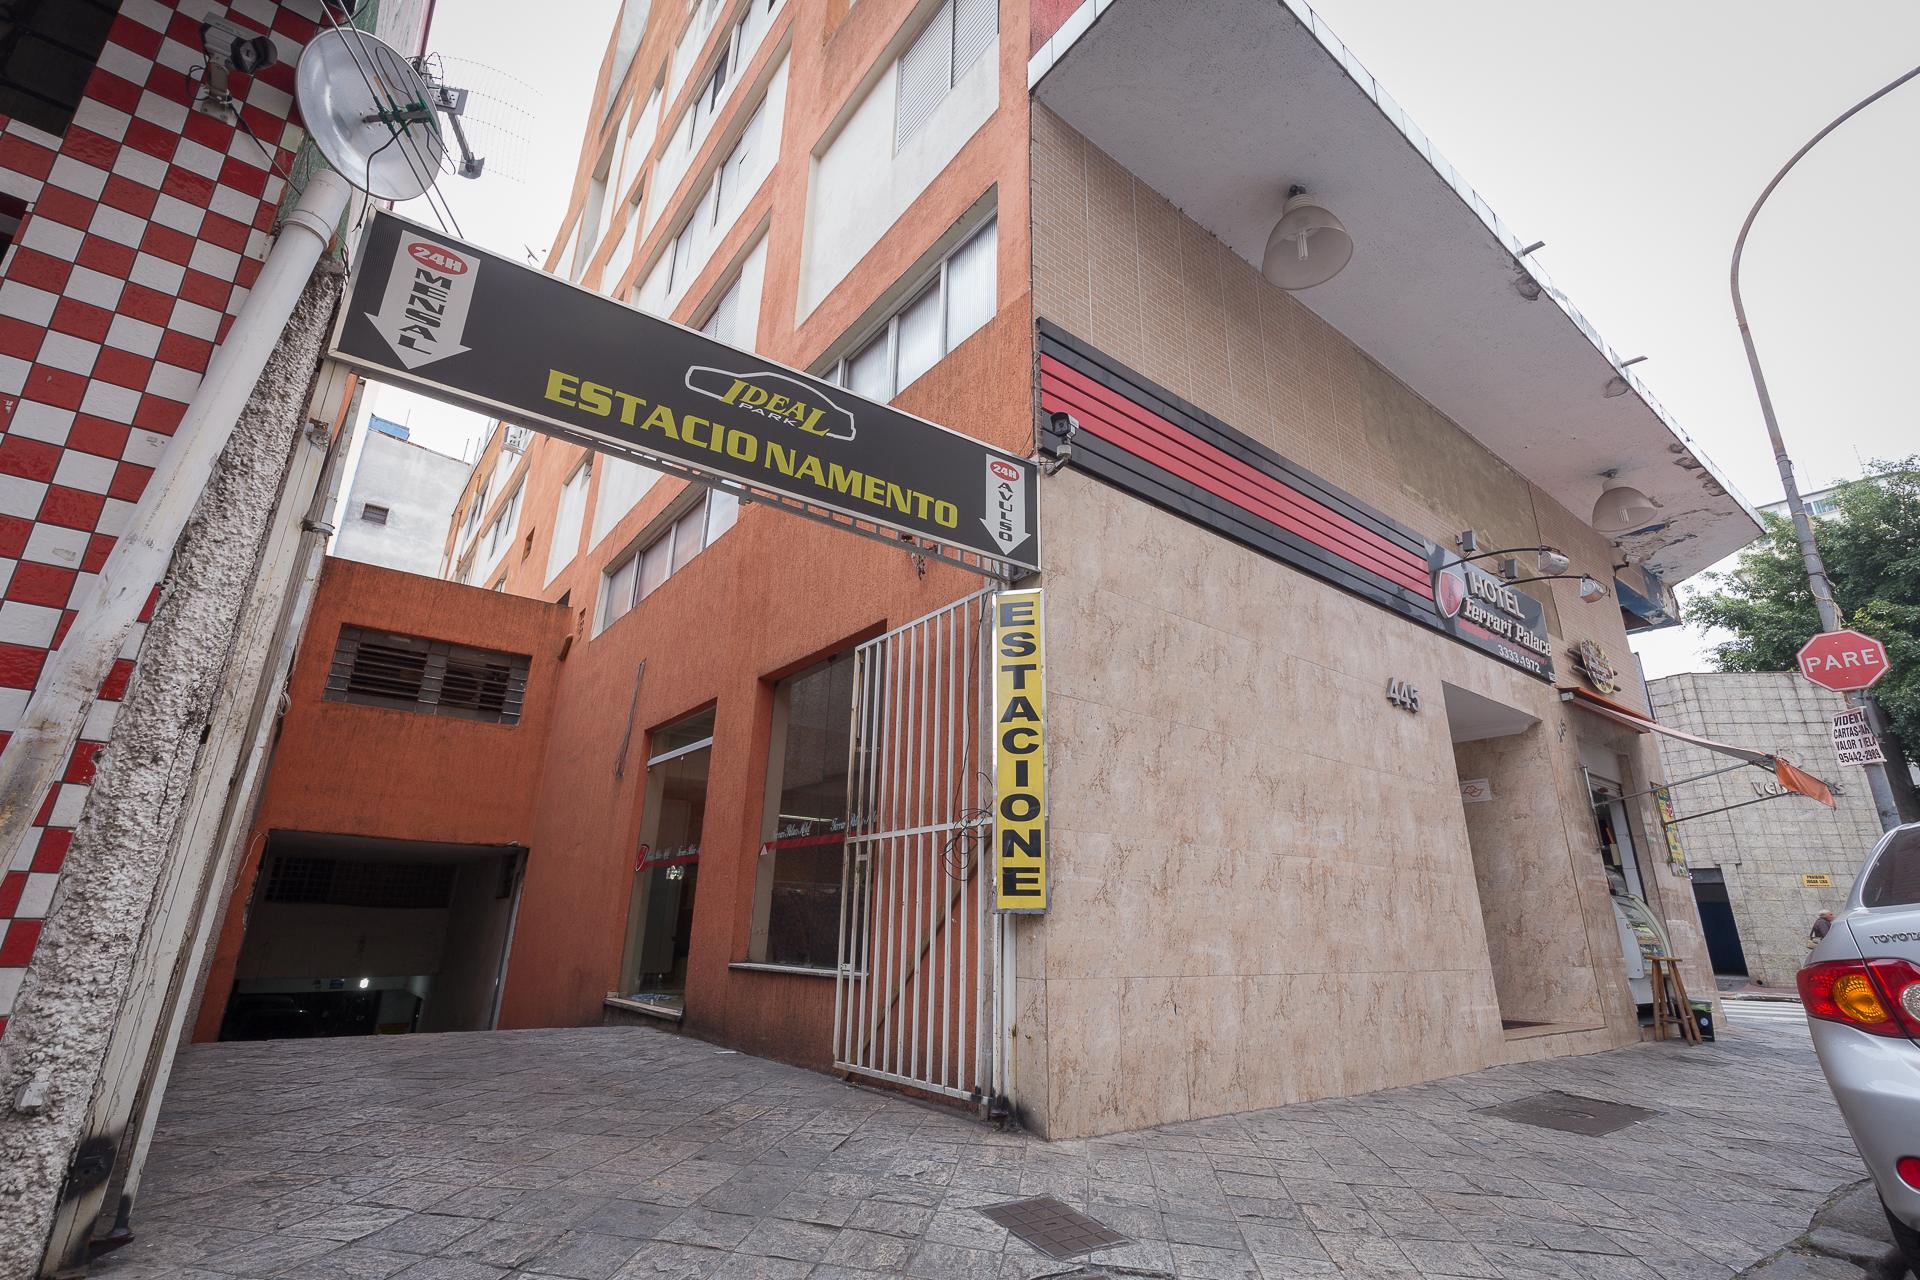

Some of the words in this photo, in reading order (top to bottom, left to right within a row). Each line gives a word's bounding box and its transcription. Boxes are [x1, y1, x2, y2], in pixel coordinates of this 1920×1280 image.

[414, 247, 462, 272] 24H
[398, 268, 452, 355] MENSAL
[720, 379, 830, 436] IDEAL
[739, 402, 798, 427] PARK
[544, 369, 958, 529] ESTACIONAMENTO
[992, 463, 1018, 480] 24H
[998, 482, 1013, 542] AVULSO
[1467, 571, 1526, 619] HOTEL
[1462, 597, 1513, 638] Ferrari
[1514, 622, 1552, 657] Palace
[1805, 648, 1880, 673] PARE
[1386, 677, 1421, 712] 445
[1000, 601, 1042, 896] ESTACIONE
[1834, 739, 1858, 751] VALOR
